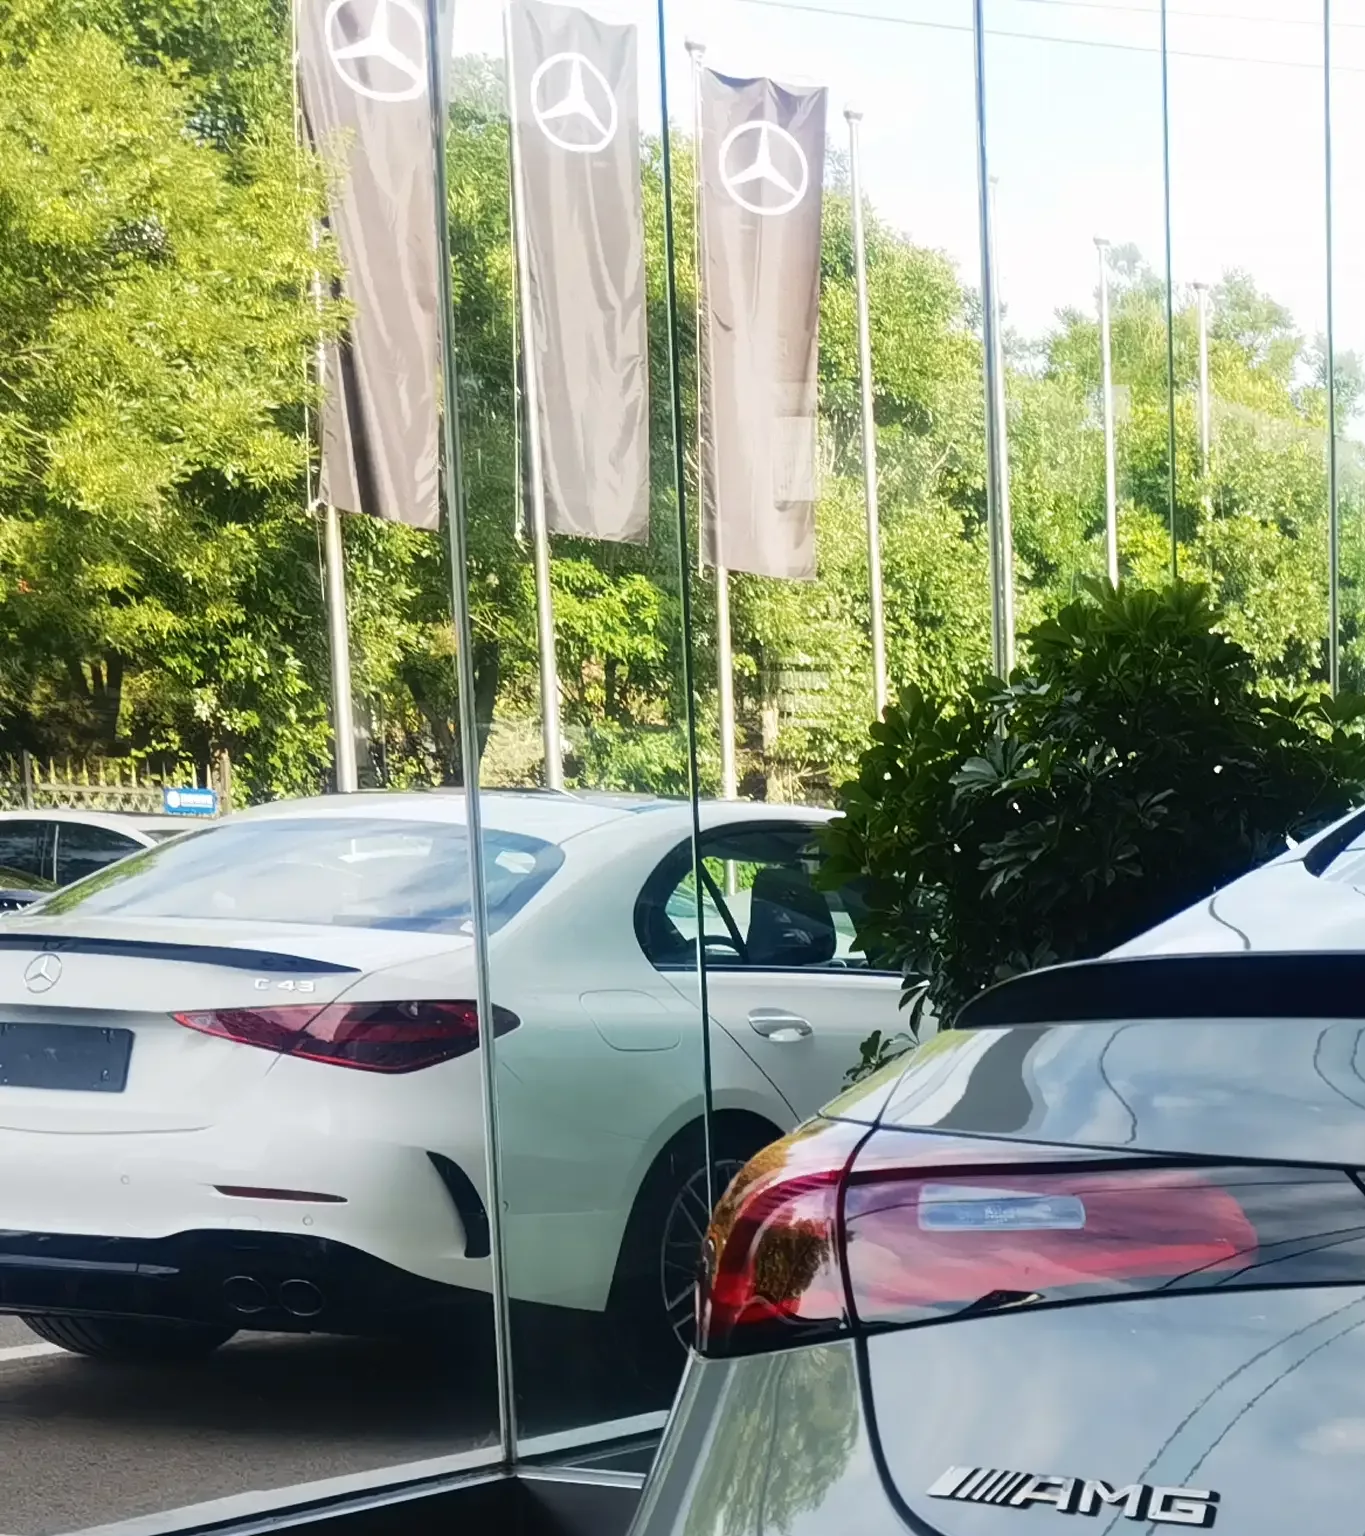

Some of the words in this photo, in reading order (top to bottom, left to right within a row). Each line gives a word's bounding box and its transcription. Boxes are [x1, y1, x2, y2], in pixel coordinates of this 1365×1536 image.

[254, 978, 271, 991] C
[277, 979, 316, 992] 43
[1009, 1473, 1221, 1529] AMG
